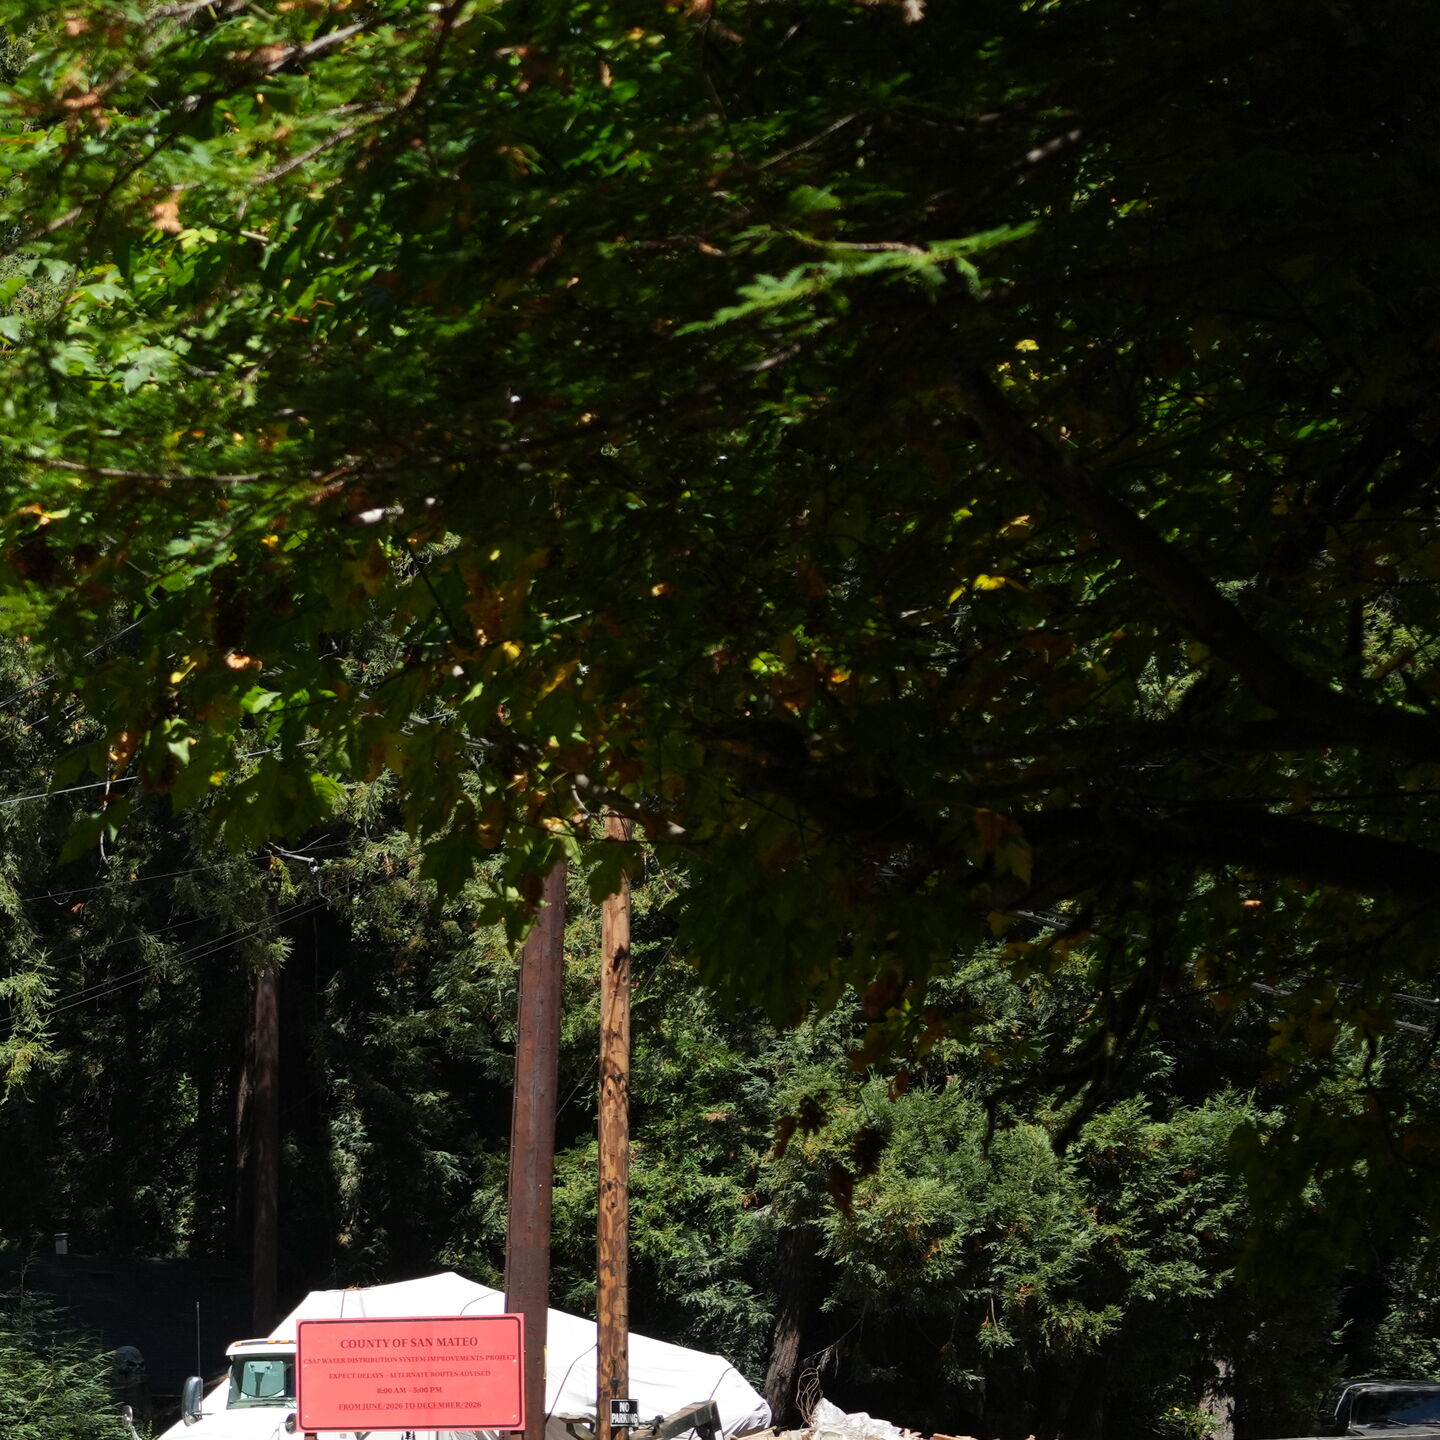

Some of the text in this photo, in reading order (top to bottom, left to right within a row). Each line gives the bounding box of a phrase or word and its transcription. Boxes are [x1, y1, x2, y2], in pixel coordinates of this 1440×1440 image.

[340, 1337, 478, 1349] COUNTY OF SAN MATEO
[405, 1402, 415, 1410] TO
[619, 1401, 630, 1412] NO
[611, 1413, 638, 1424] PARKING
